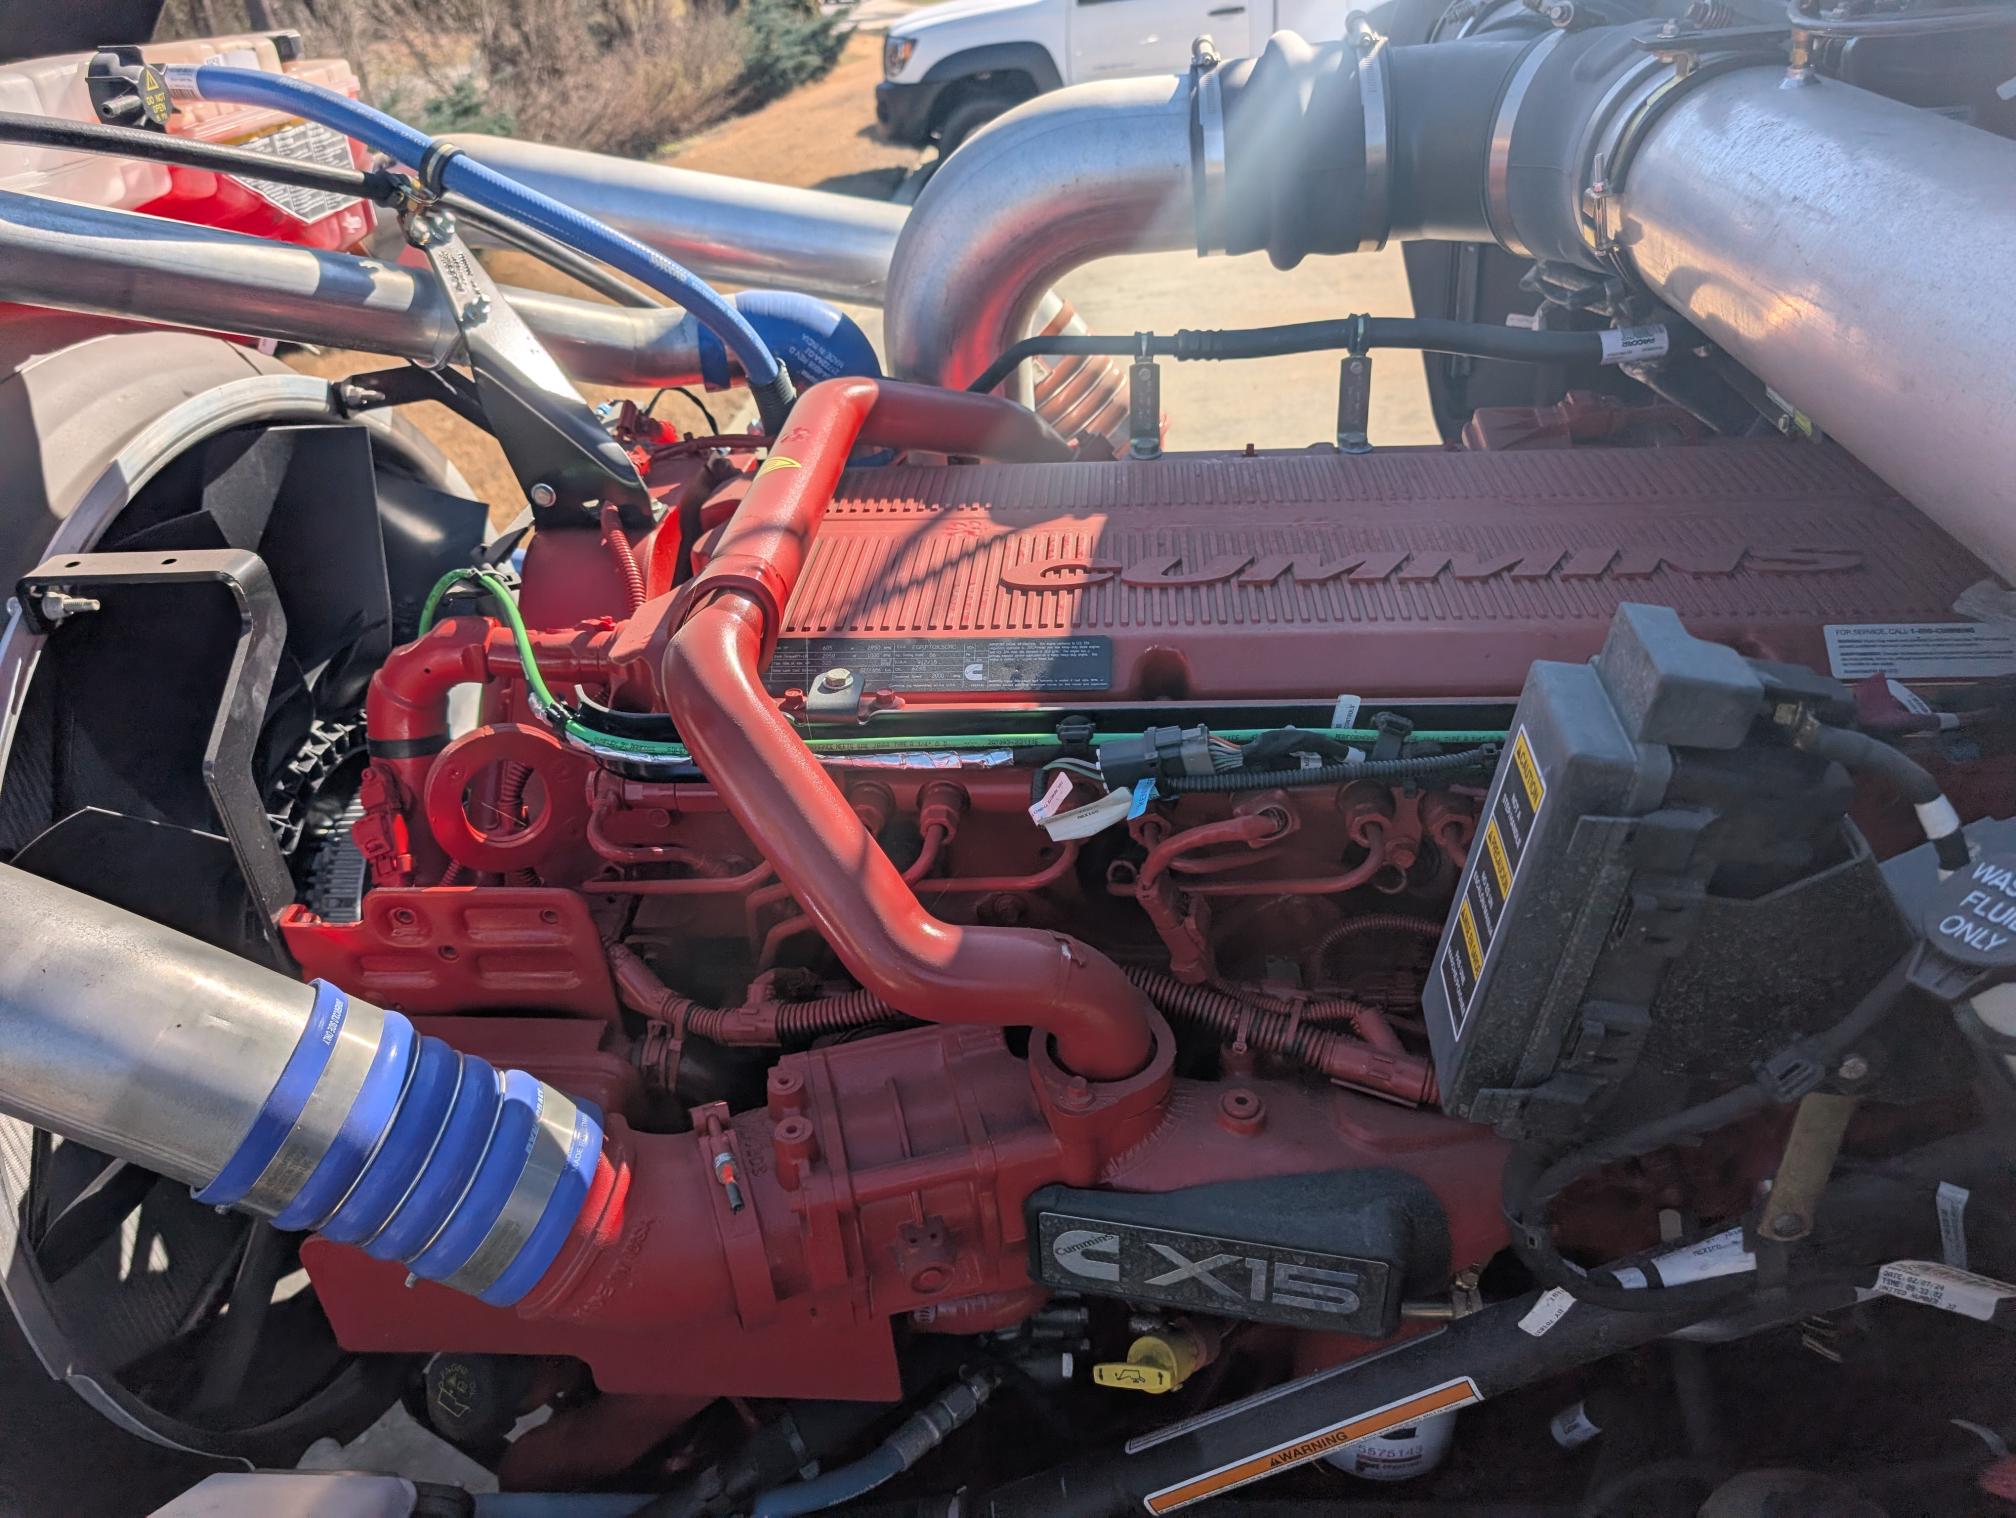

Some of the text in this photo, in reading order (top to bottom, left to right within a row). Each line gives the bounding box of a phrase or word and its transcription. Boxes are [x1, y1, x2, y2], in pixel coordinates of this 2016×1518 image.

[1518, 751, 1541, 805] CAUTION
[1939, 915, 2008, 952] ONLY
[1056, 1233, 1115, 1257] Cummins
[1144, 1242, 1360, 1315] X15
[1279, 1432, 1349, 1464] WARNING
